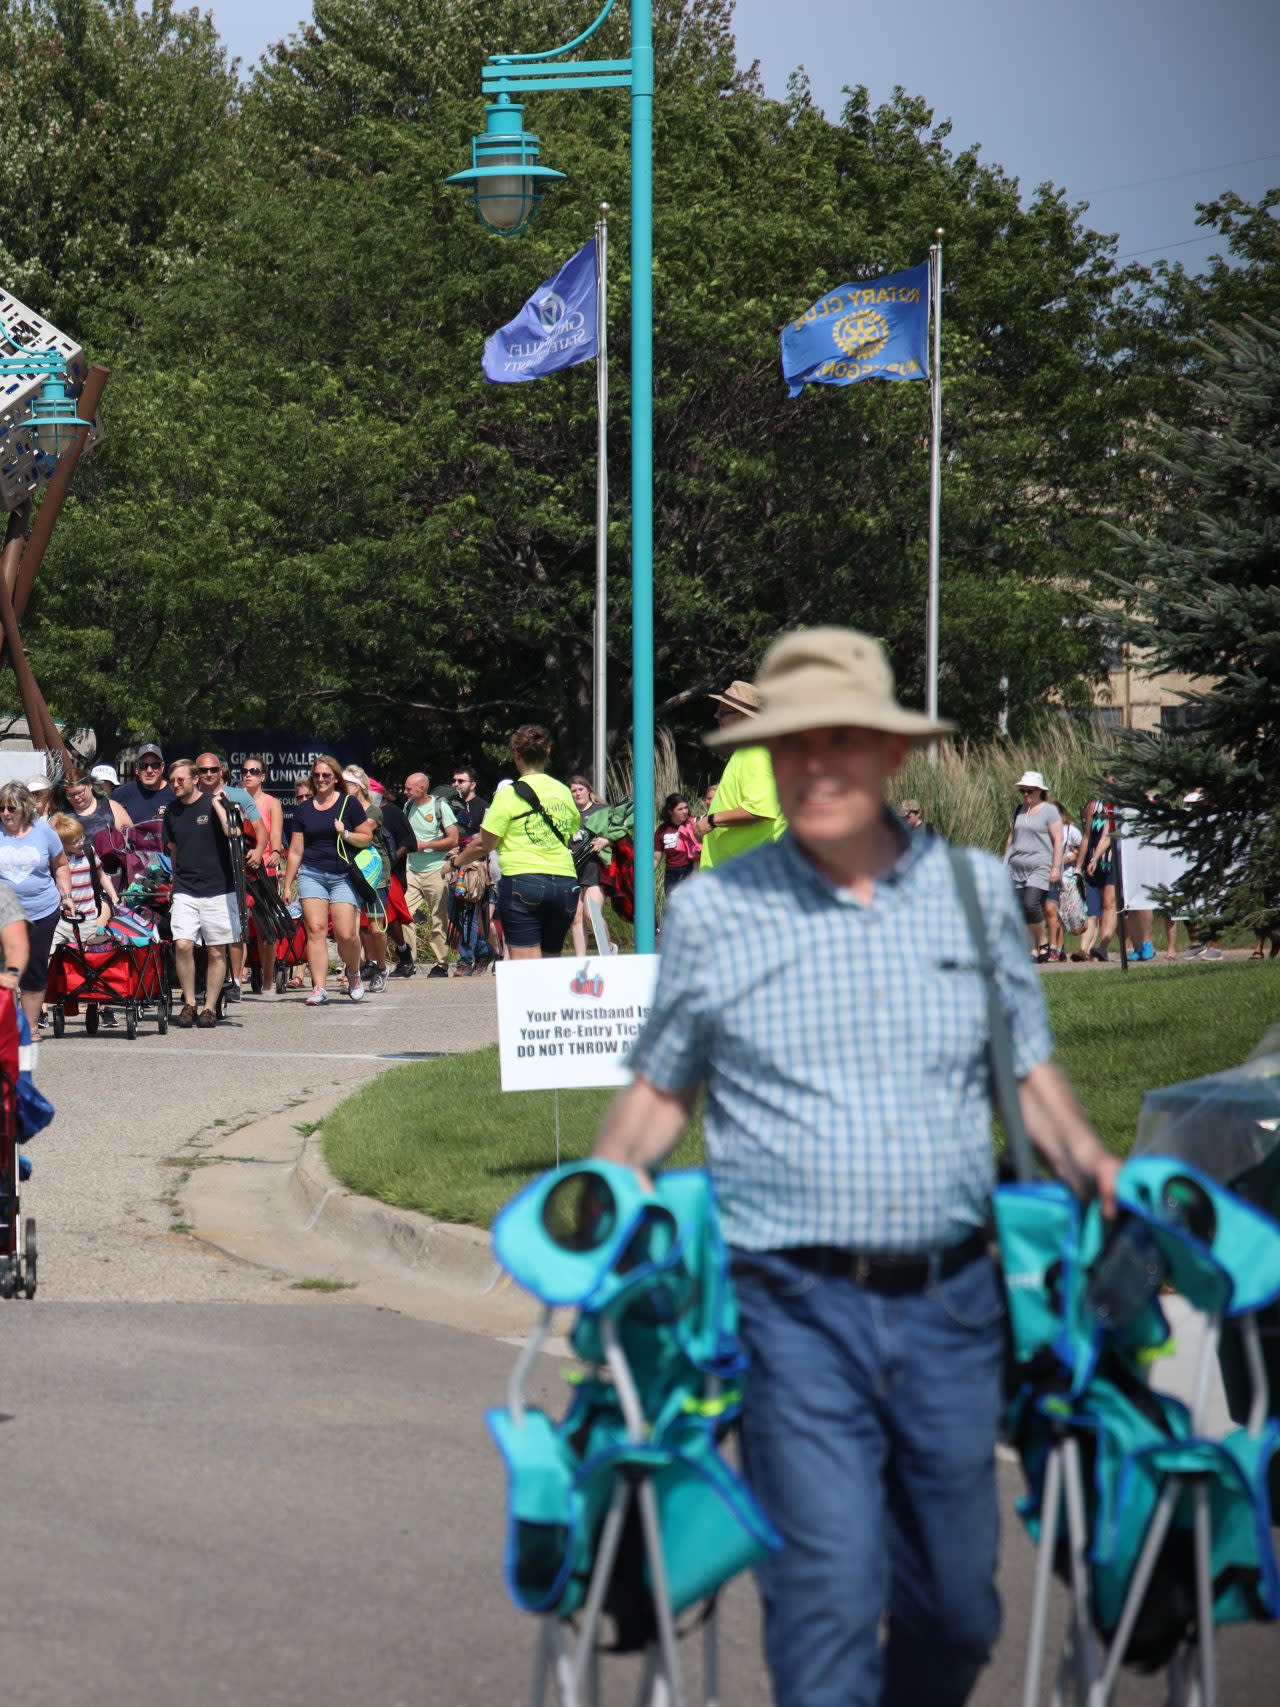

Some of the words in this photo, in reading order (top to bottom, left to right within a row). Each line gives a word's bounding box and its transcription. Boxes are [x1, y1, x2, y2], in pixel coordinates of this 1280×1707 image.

[527, 1010, 557, 1023] Your
[560, 1006, 634, 1022] Wristband
[520, 1027, 550, 1041] Your
[554, 1024, 613, 1038] Re-Entry
[517, 1045, 535, 1058] DO
[539, 1044, 565, 1057] NOT
[568, 1041, 618, 1055] THROW
